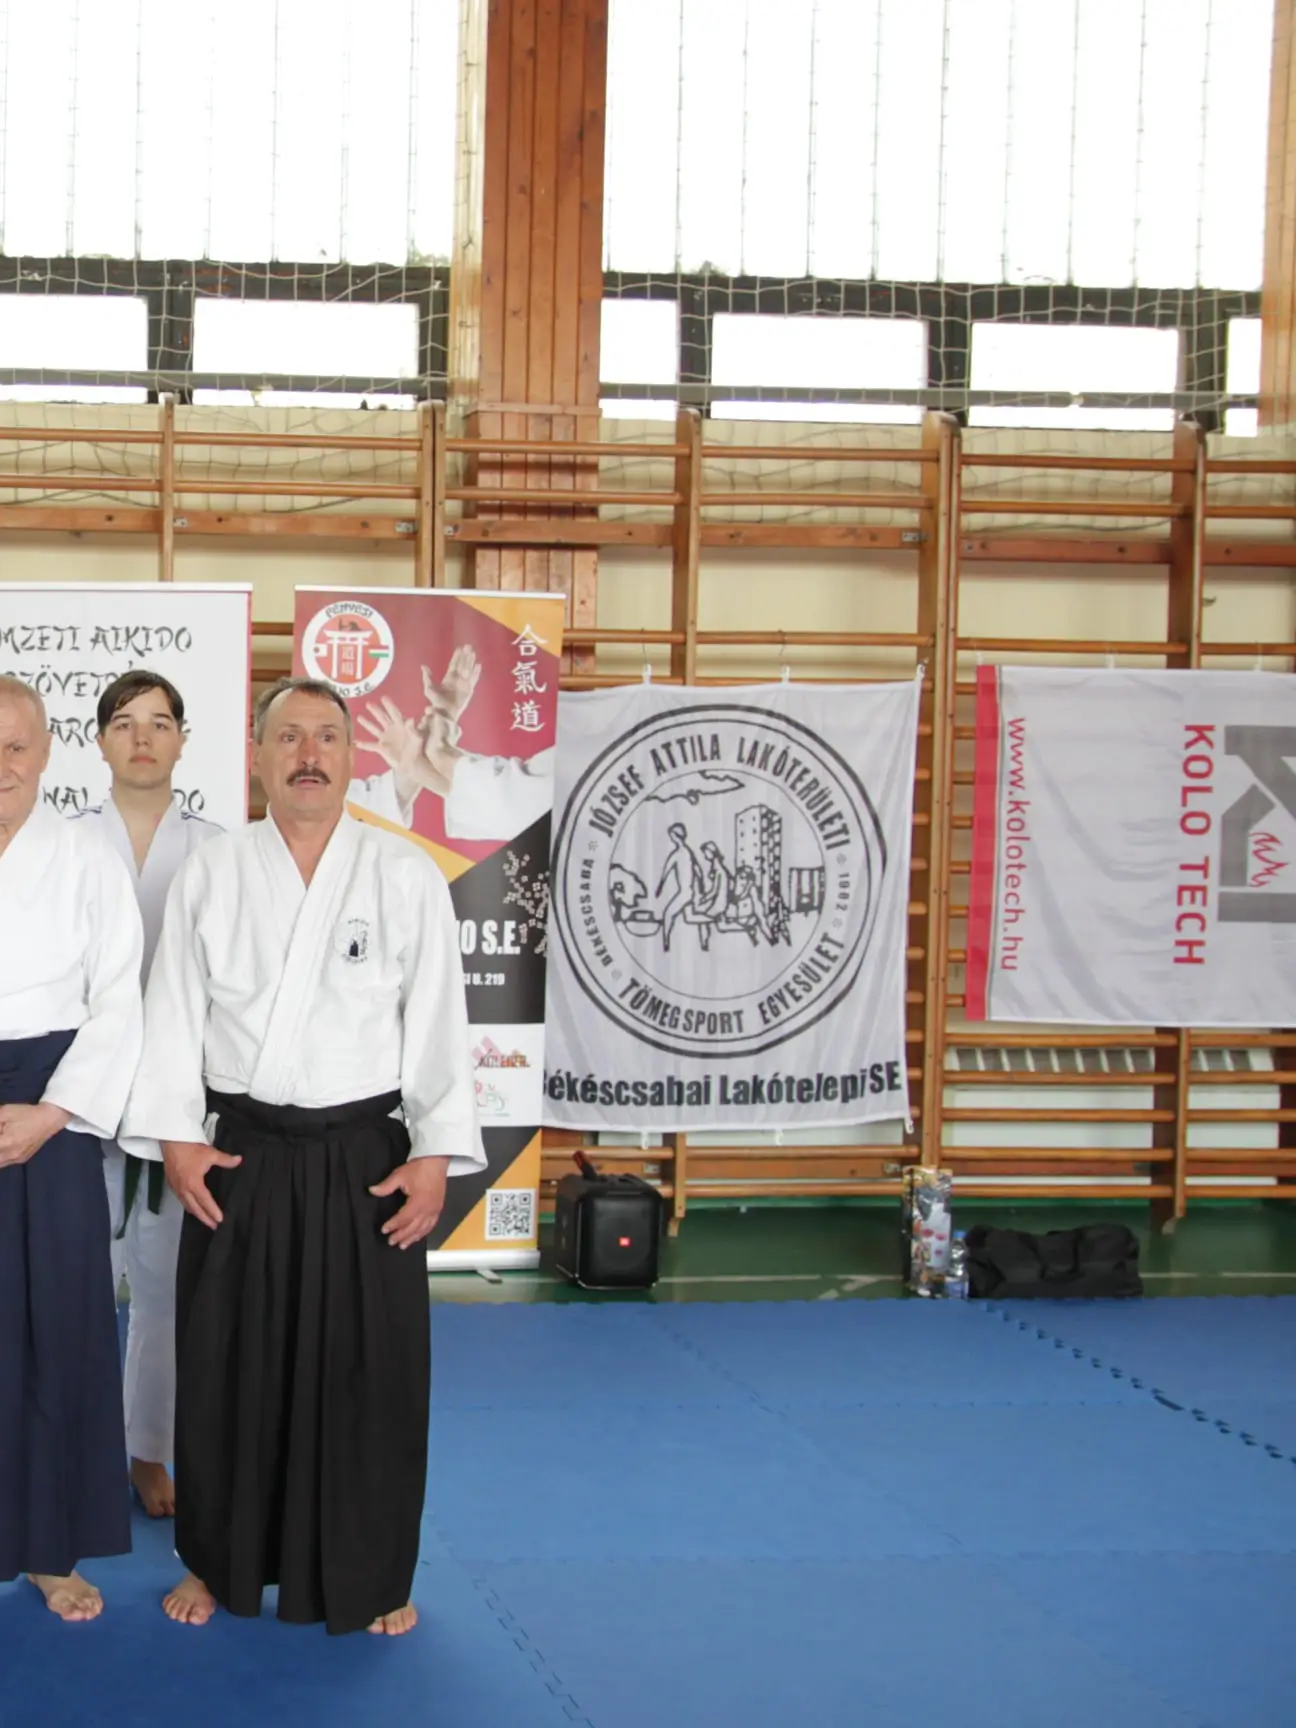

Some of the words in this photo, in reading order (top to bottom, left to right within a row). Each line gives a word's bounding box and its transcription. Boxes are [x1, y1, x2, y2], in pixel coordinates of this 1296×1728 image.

[90, 625, 192, 657] AIKIDO
[588, 764, 645, 838] JÓZSEF
[650, 733, 721, 776] ATTILA
[736, 736, 851, 850] LAKÓTERÜLETI
[1179, 724, 1216, 836] KOLO
[1000, 717, 1031, 971] www.kolotech.hu
[481, 919, 521, 955] S.E.
[1173, 855, 1210, 965] TECH
[618, 977, 745, 1035] TÖMEGSPORT
[757, 932, 845, 1026] EGYESÜLET
